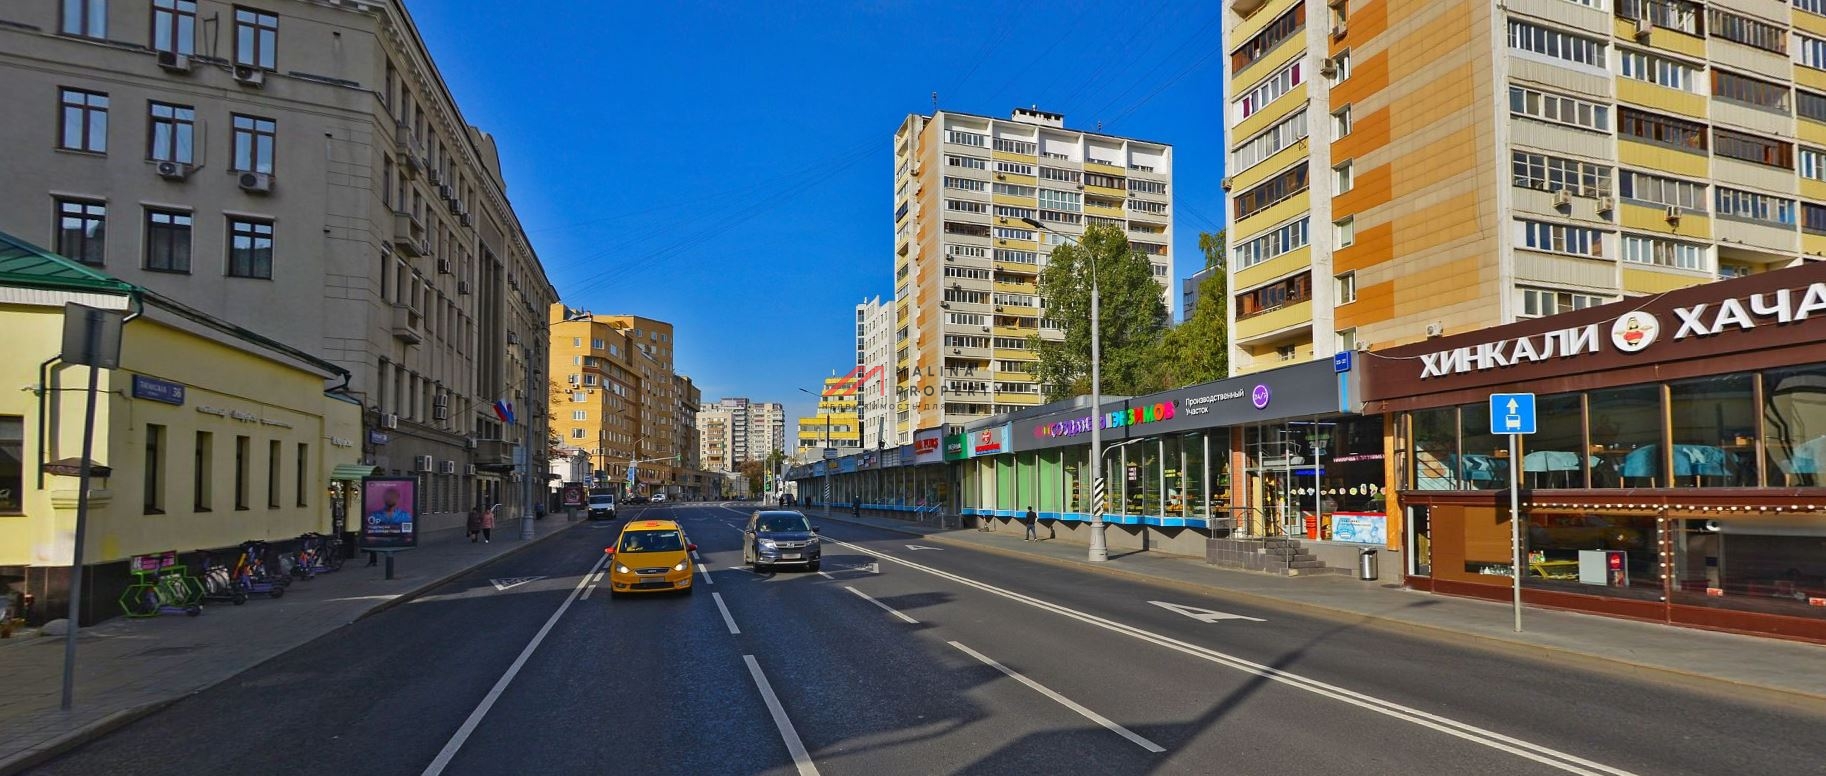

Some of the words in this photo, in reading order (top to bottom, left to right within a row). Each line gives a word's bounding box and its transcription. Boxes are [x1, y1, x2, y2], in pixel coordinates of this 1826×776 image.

[1419, 324, 1600, 379] ХИНКАЛИ
[1673, 283, 1826, 339] ХАЧА
[1185, 388, 1245, 407] Производственный
[1111, 401, 1175, 428] ЭНЗИМОВ
[1185, 406, 1209, 416] Участок
